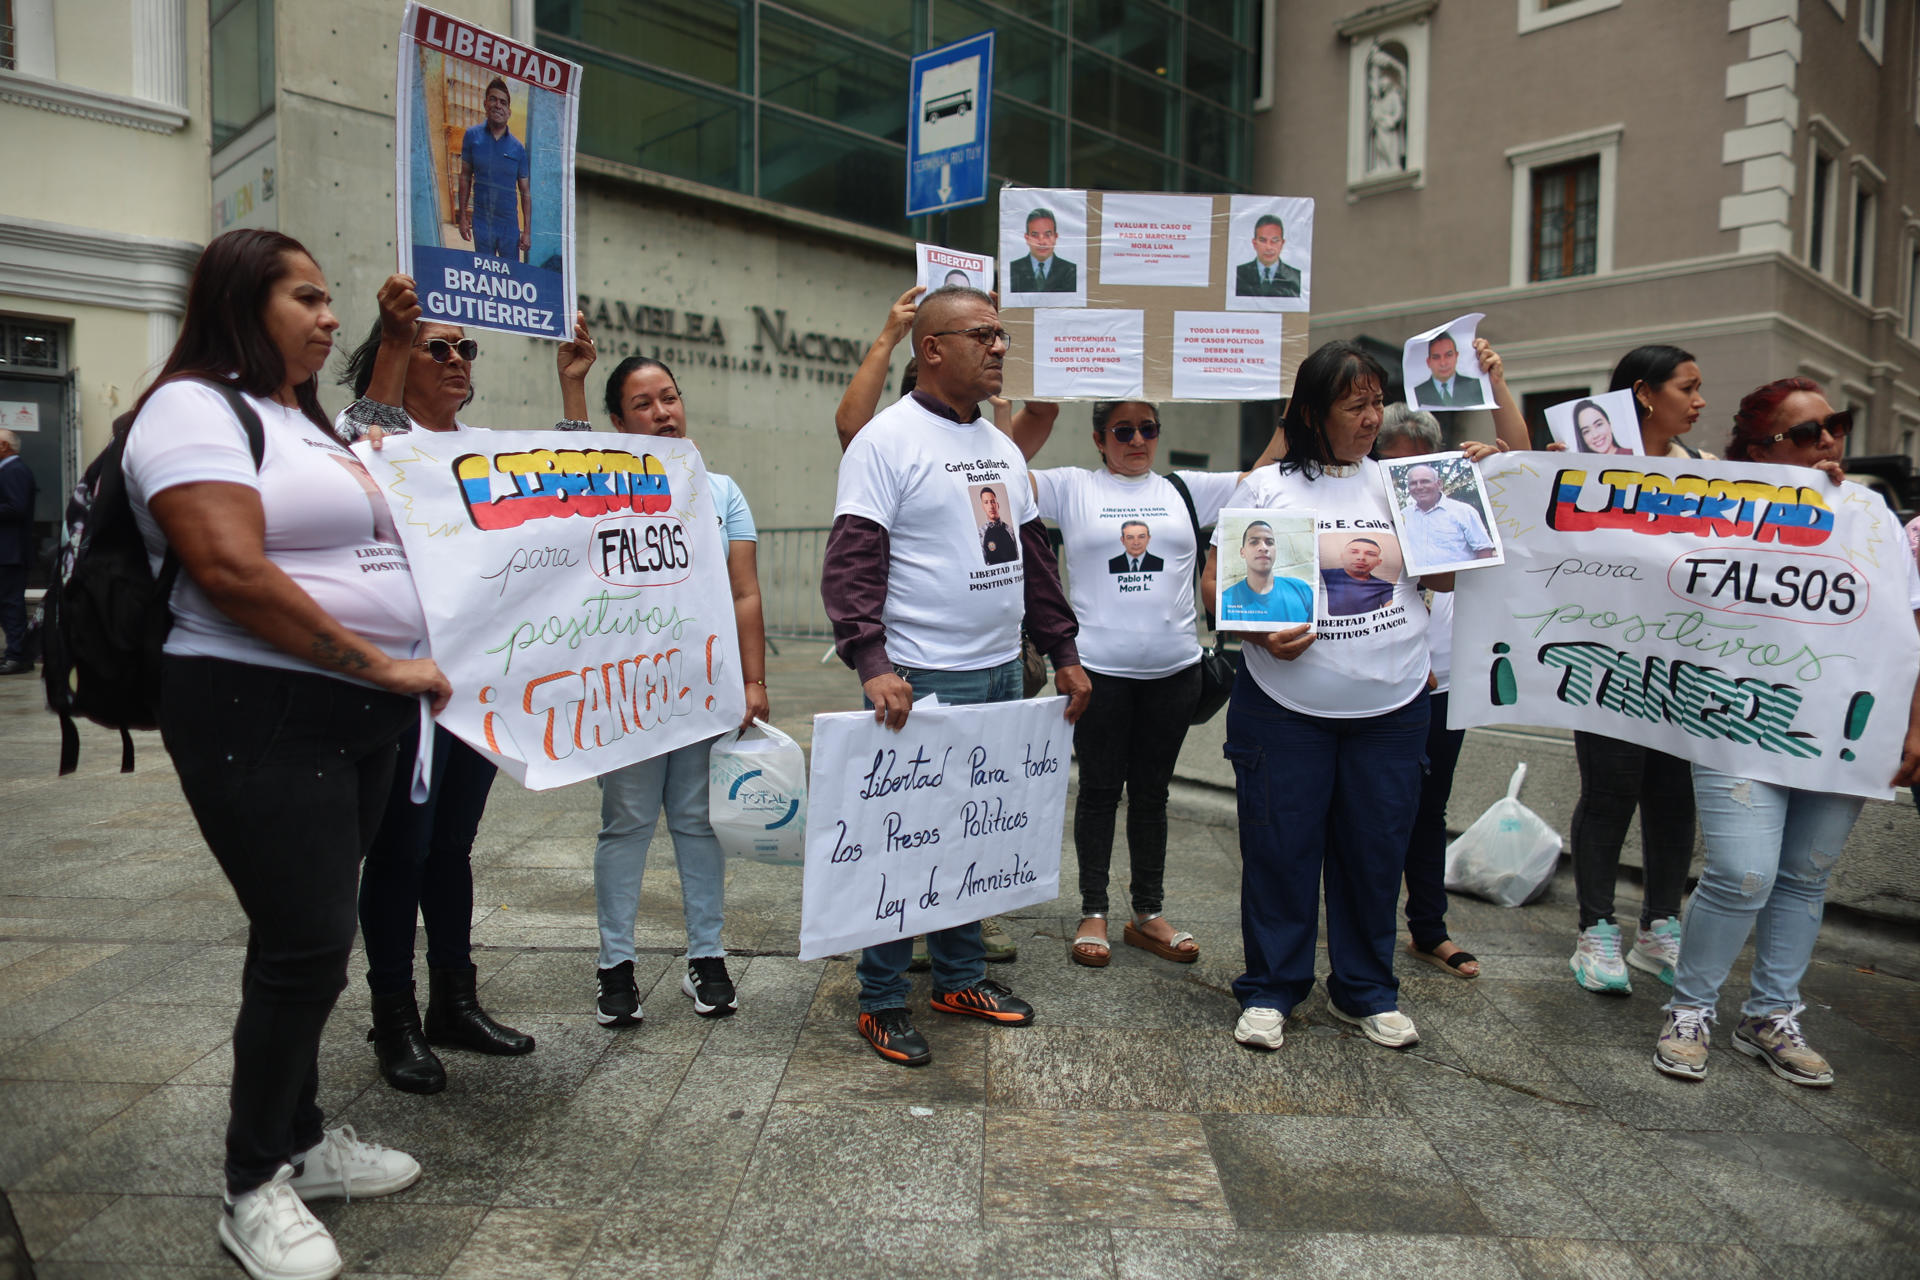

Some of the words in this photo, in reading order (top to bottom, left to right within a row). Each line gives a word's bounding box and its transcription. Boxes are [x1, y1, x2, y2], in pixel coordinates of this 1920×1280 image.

[426, 15, 562, 88] LIBERTAD
[913, 155, 949, 173] TERMINAL
[473, 257, 511, 275] PARA
[930, 251, 981, 270] LIBERTAD
[444, 268, 538, 303] BRANDO
[427, 291, 555, 331] GUTIÉRREZ
[779, 363, 799, 380] DE
[945, 461, 975, 473] Carlos
[976, 459, 1010, 470] Gallardo
[966, 470, 1001, 482] Rondón
[452, 448, 673, 532] LIBERTAD
[1545, 467, 1835, 547] LIBERTAD
[1336, 519, 1351, 529] E.
[481, 543, 579, 598] para
[598, 522, 689, 577] FALSOS
[969, 564, 1010, 580] LIBERTAD
[969, 576, 1014, 591] POSITIVOS
[1117, 574, 1142, 584] Pablo
[1143, 573, 1154, 582] M.
[1119, 584, 1142, 593] Mora
[1526, 557, 1644, 589] para
[1684, 558, 1857, 616] FALSOS
[1317, 616, 1366, 628] IBERTAD
[1372, 605, 1405, 621] FALSOS
[486, 590, 697, 676] positivos
[1316, 628, 1370, 641] OSITIVOS
[1373, 617, 1408, 633] TANCOL
[1513, 603, 1857, 681] positivos
[859, 744, 953, 800] Libertad
[967, 745, 1010, 788] Para
[1021, 740, 1059, 779] todos
[739, 793, 788, 805] TOTAL
[831, 819, 863, 864] Los
[883, 811, 941, 853] Presos
[960, 797, 1029, 839] Politicos
[876, 872, 906, 933] Ley
[919, 865, 940, 910] de
[956, 853, 1038, 901] Amnistía
